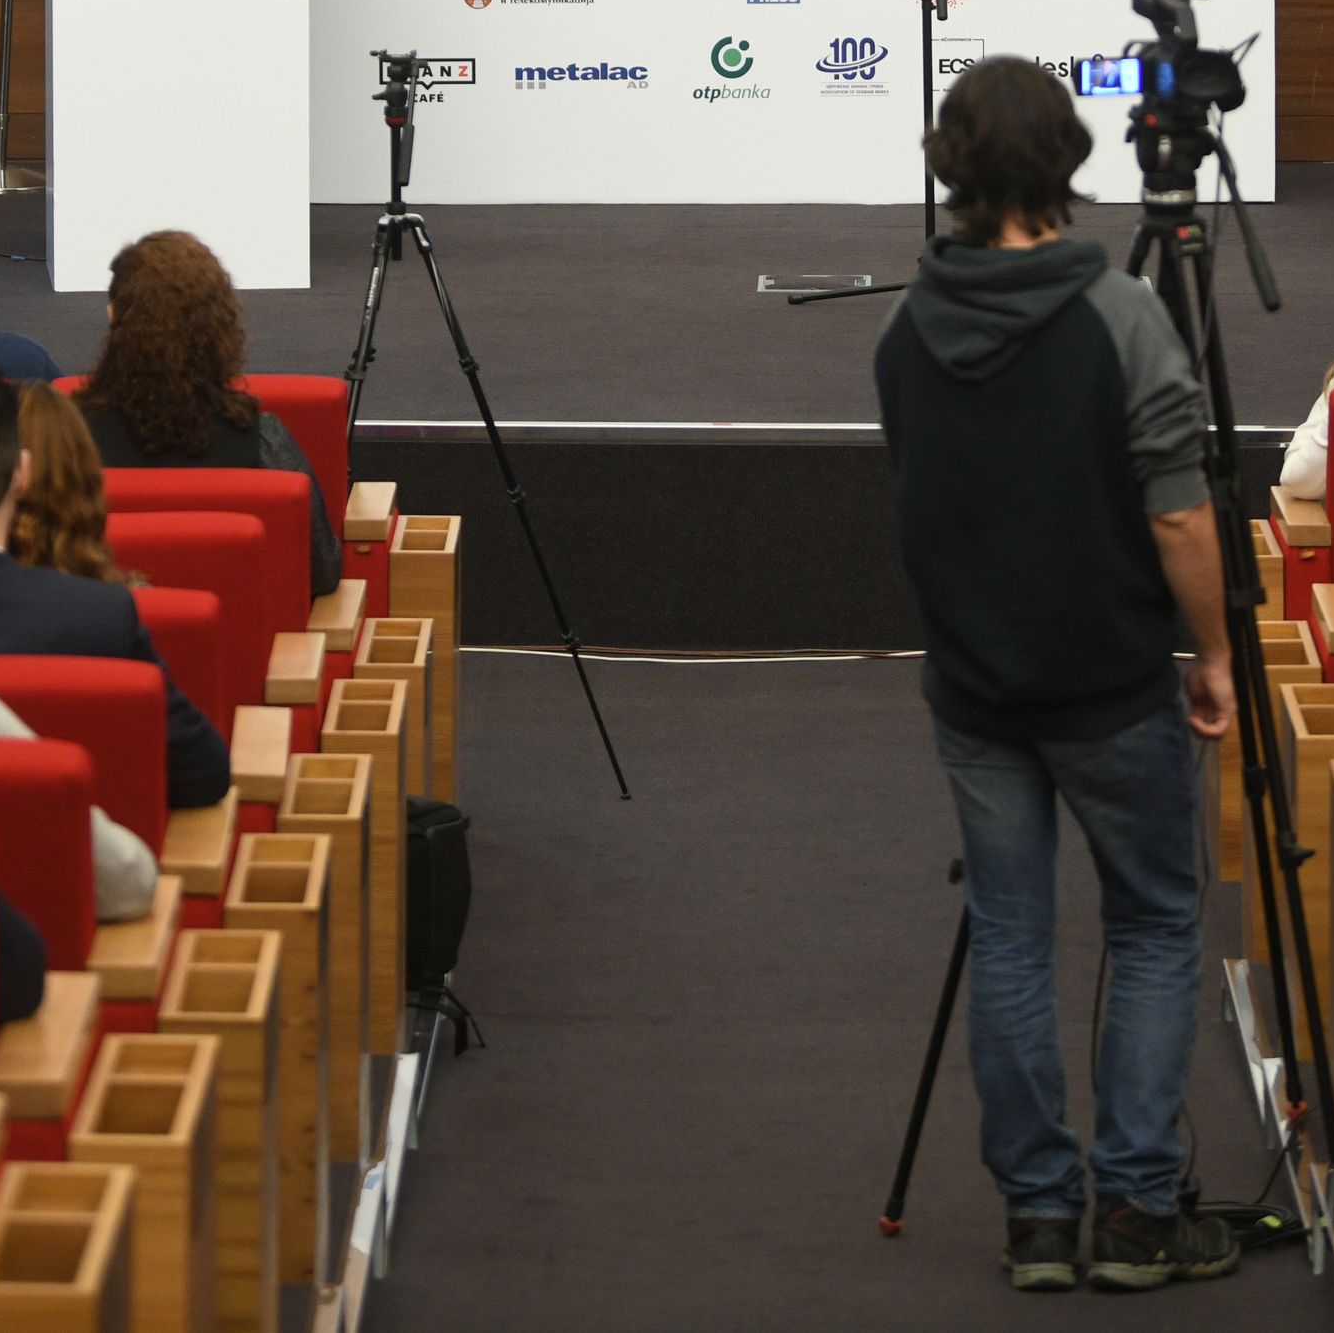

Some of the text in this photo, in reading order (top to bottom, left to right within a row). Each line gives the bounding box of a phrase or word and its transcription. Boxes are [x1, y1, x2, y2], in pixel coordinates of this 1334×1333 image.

[829, 37, 875, 80] 100
[515, 62, 649, 81] metalac
[626, 80, 649, 90] AD
[693, 84, 771, 104] otpbanka
